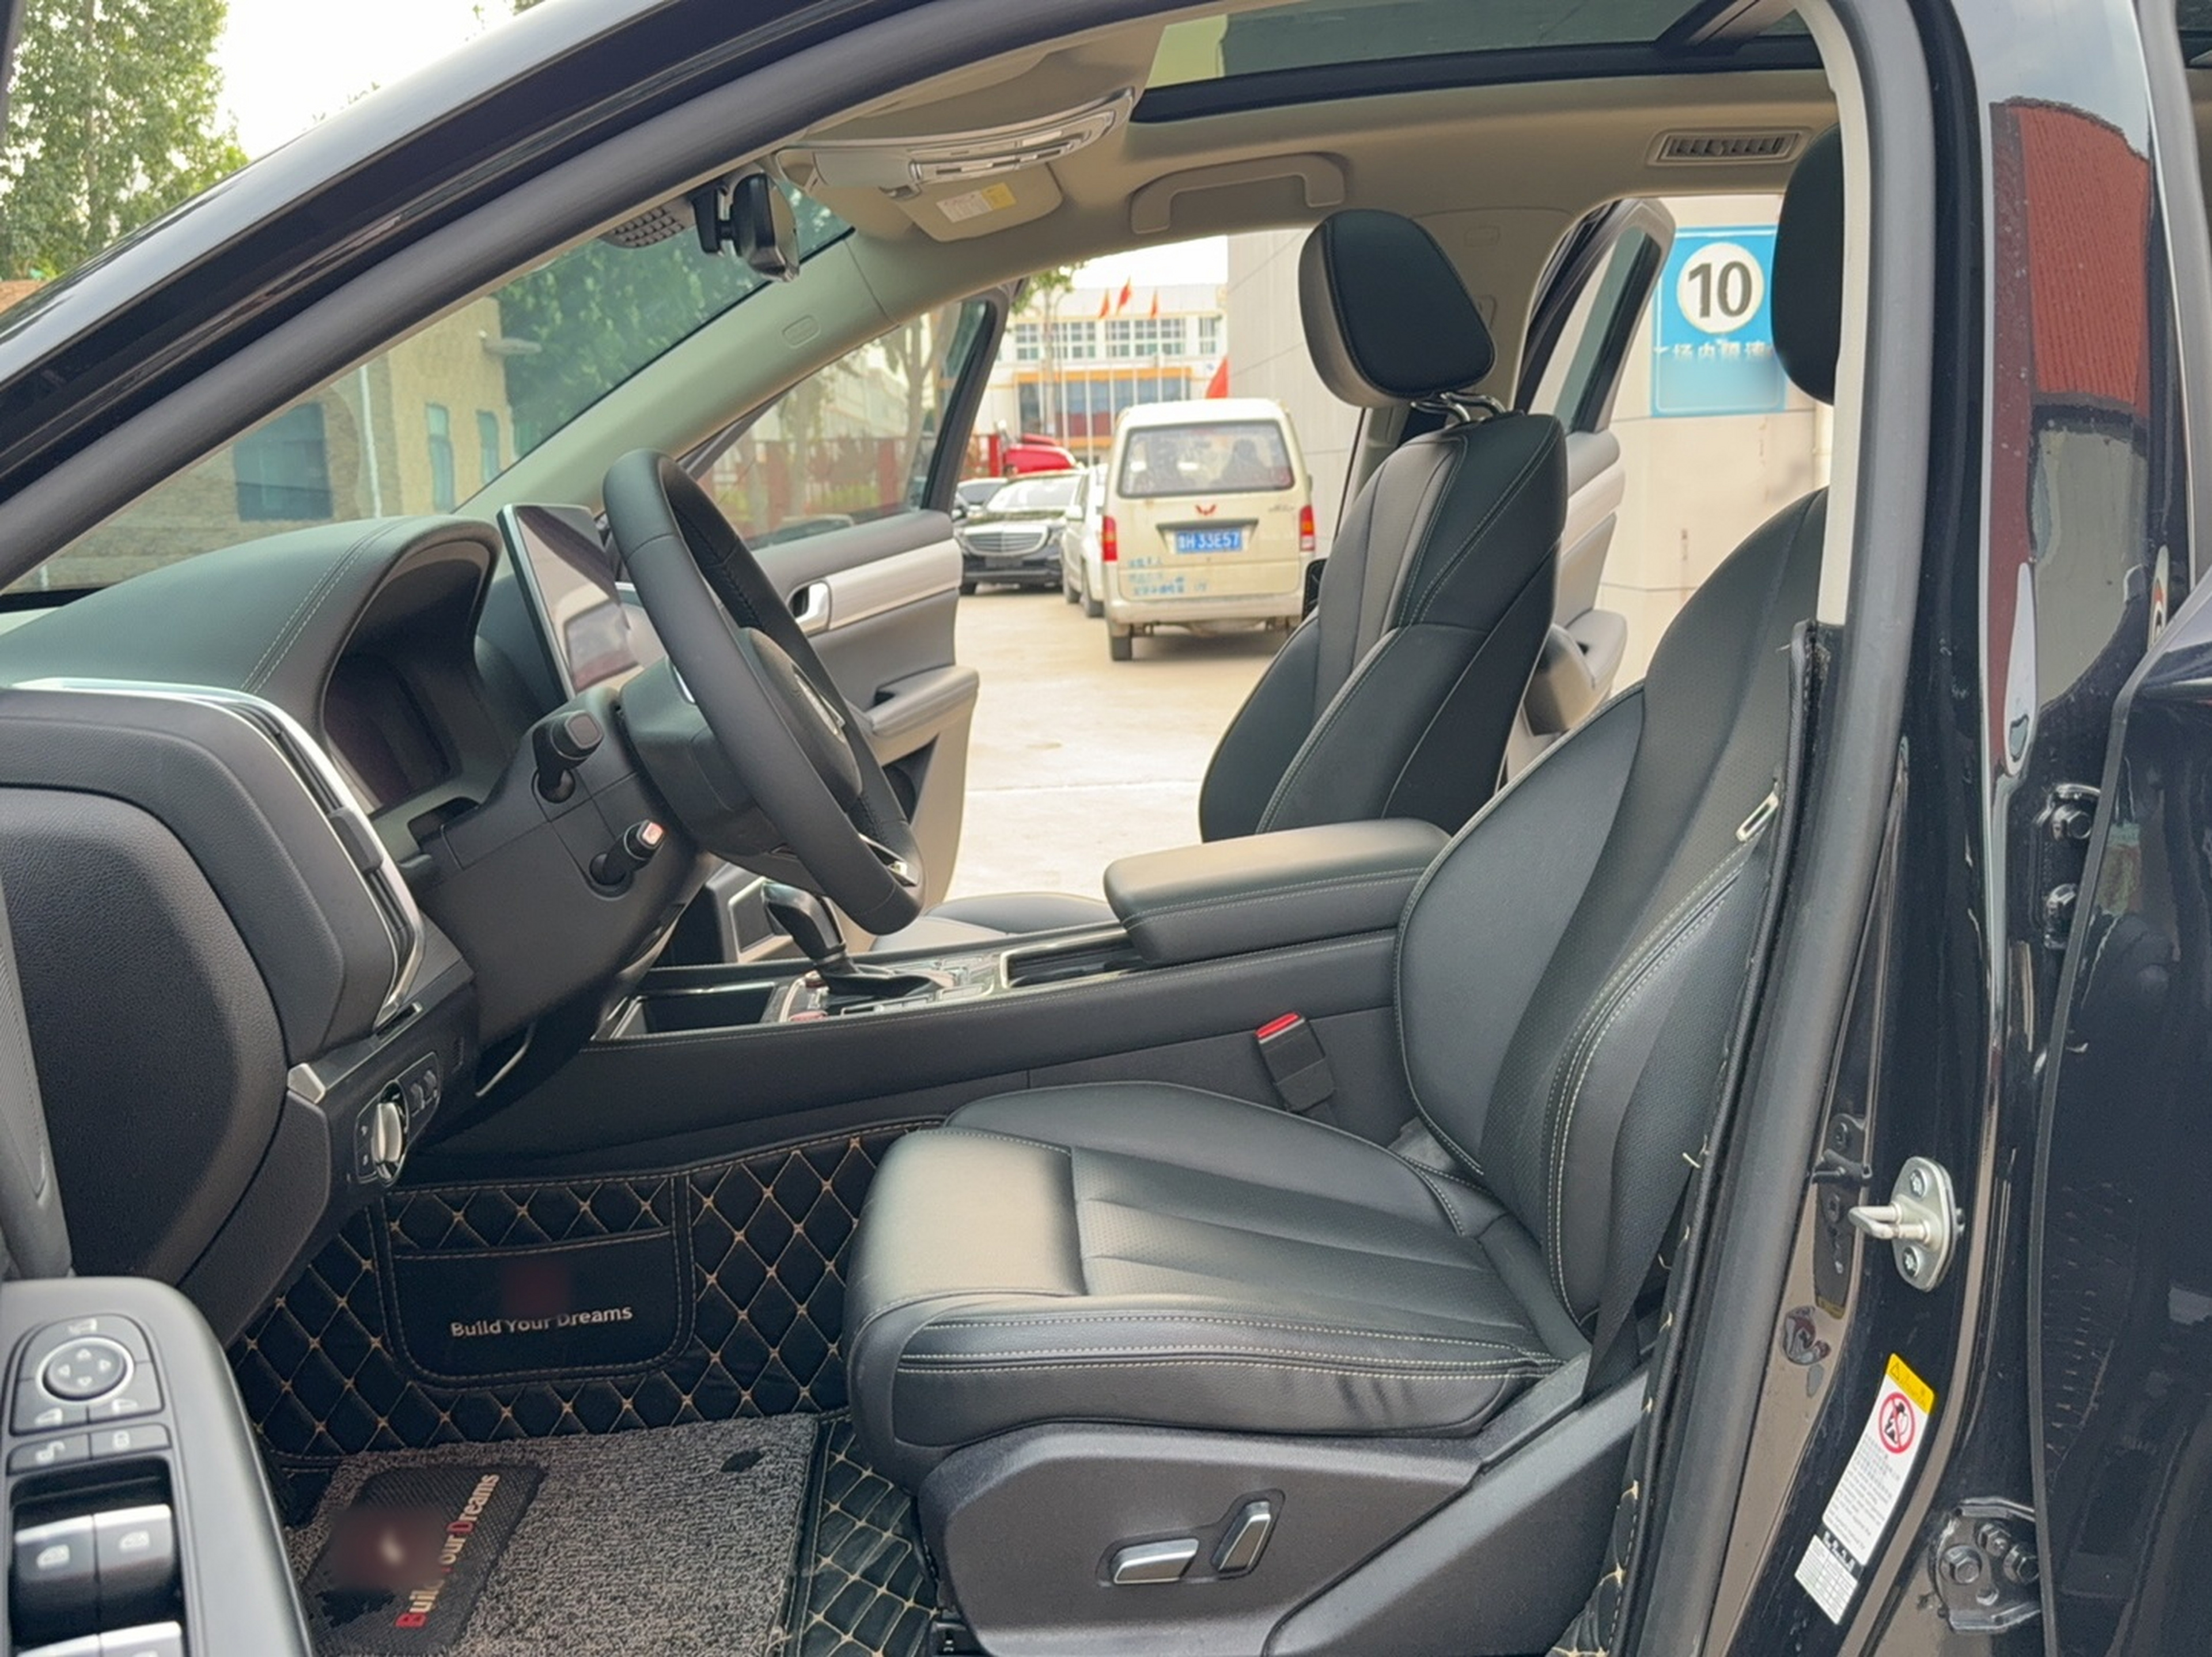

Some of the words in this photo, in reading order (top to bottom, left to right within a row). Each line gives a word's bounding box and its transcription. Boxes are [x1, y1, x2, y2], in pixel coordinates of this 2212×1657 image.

[1687, 260, 1753, 319] 10
[450, 1319, 502, 1337] Build
[505, 1318, 550, 1333] Your
[556, 1306, 633, 1327] Dreams
